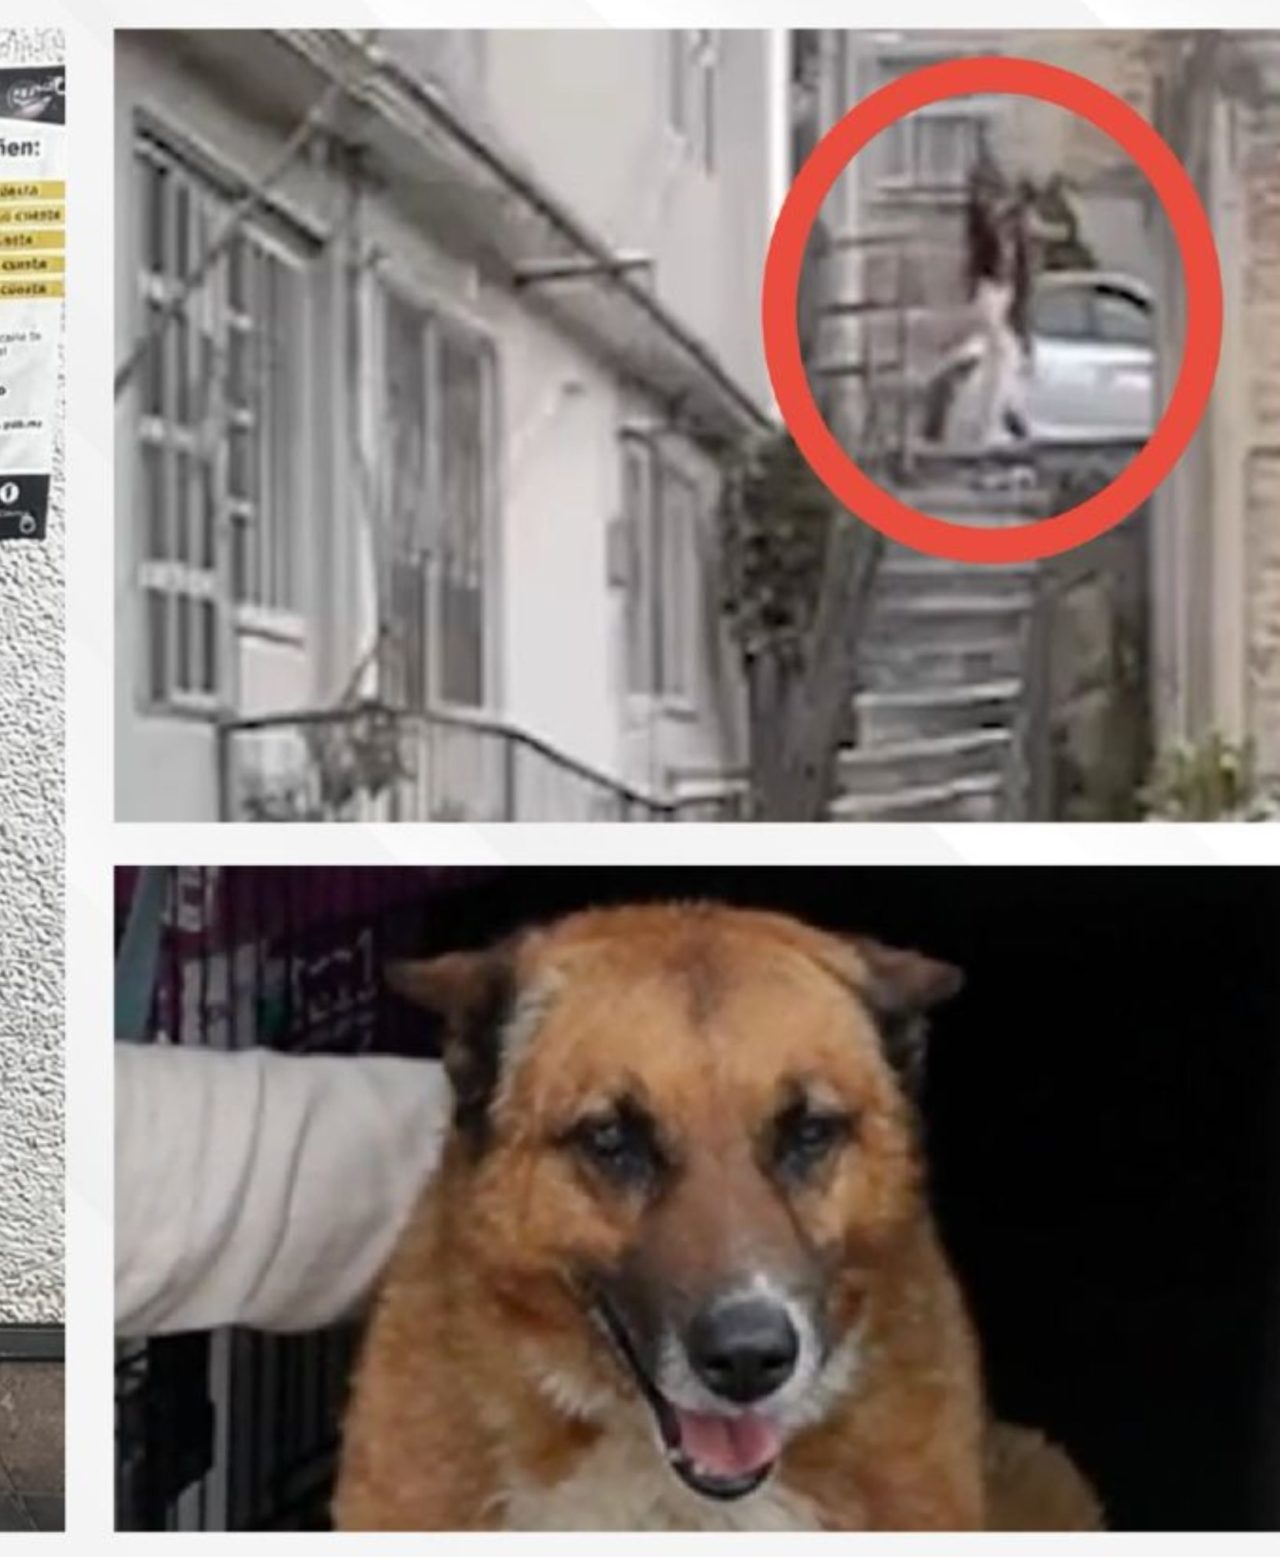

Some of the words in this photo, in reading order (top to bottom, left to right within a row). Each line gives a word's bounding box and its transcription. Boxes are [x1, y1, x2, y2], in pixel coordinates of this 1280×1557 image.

[14, 209, 60, 221] cuesta
[1, 258, 47, 271] cuesta
[0, 283, 46, 295] cuesta
